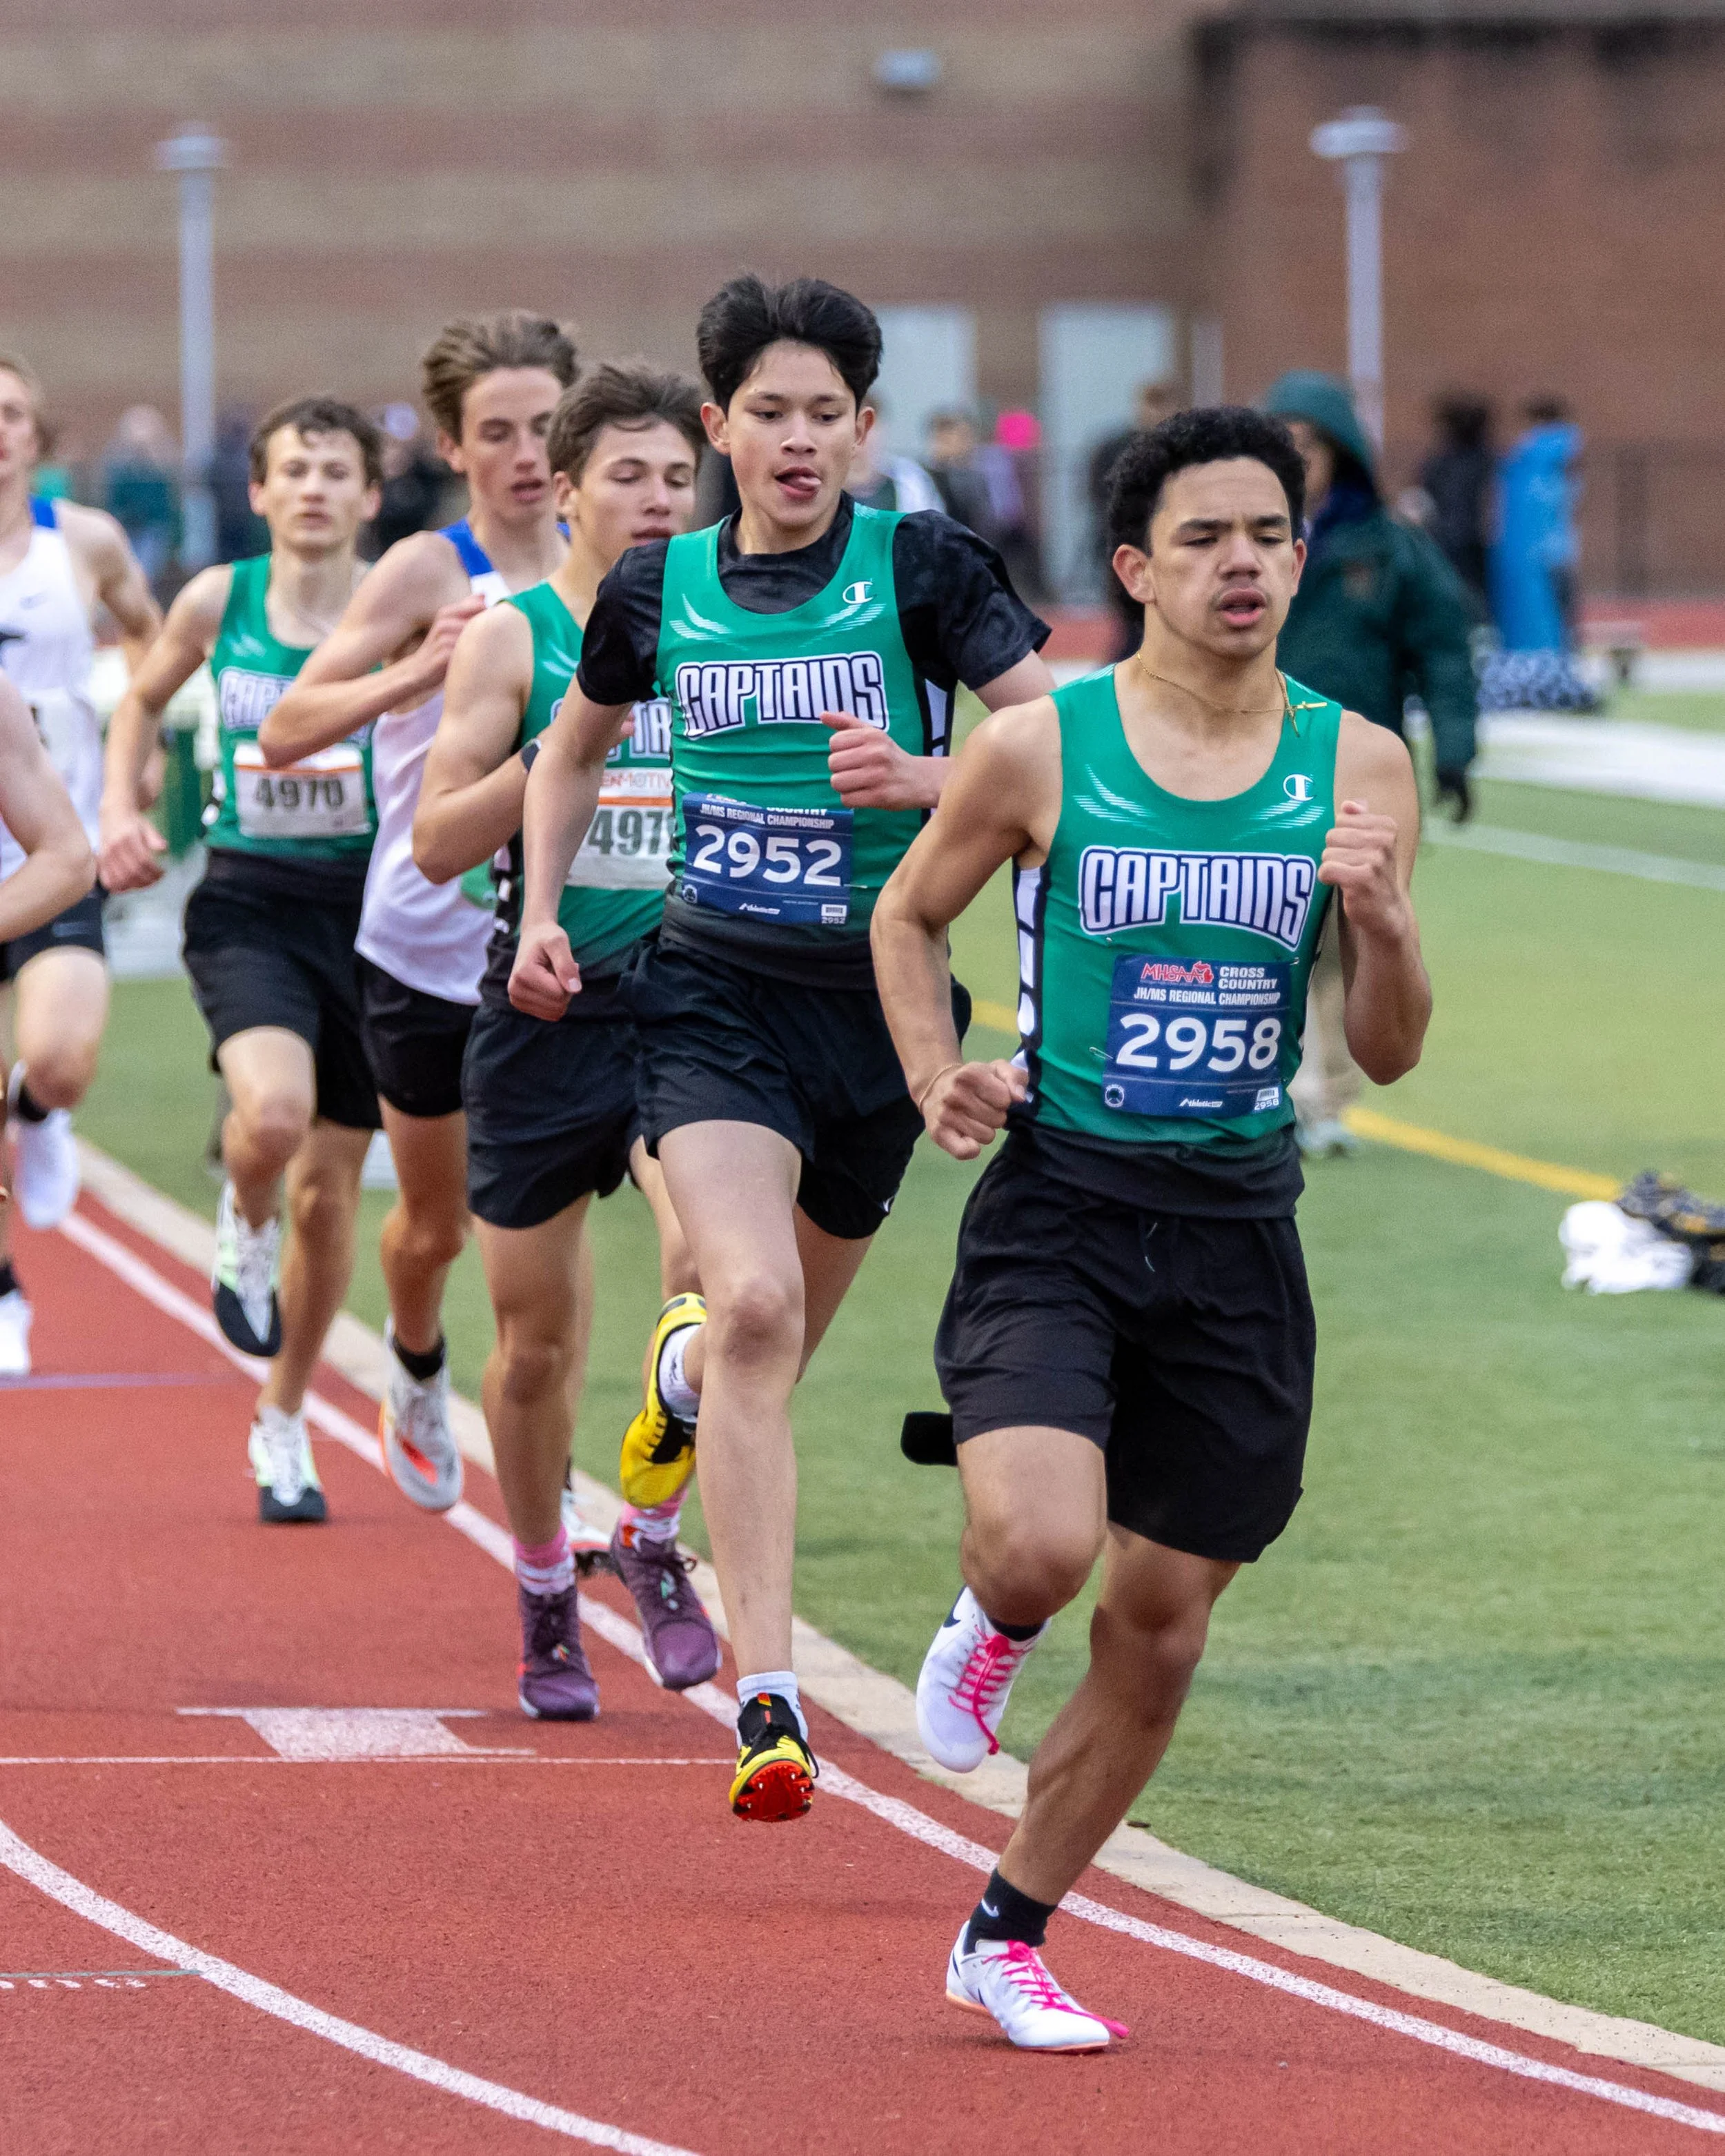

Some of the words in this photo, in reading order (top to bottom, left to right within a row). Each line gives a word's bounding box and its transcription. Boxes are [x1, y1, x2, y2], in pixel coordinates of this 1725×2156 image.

[676, 651, 889, 738] CAPTAINS
[727, 807, 765, 824] REGIONAL
[767, 814, 834, 829] CHAMPIONSHIP
[692, 824, 842, 887] 2952
[1079, 846, 1316, 950] CAPTAINS
[821, 916, 845, 924] 2952
[1141, 962, 1205, 984] MHSAA
[1219, 966, 1265, 978] CROSS
[1219, 978, 1278, 990] COUNTRY
[1134, 987, 1167, 1002] JH/MS
[1169, 989, 1216, 1005] REGIONAL
[1219, 991, 1281, 1006] CHAMPIONSHIP
[1116, 1013, 1281, 1072] 2958
[1254, 1098, 1279, 1111] 2958
